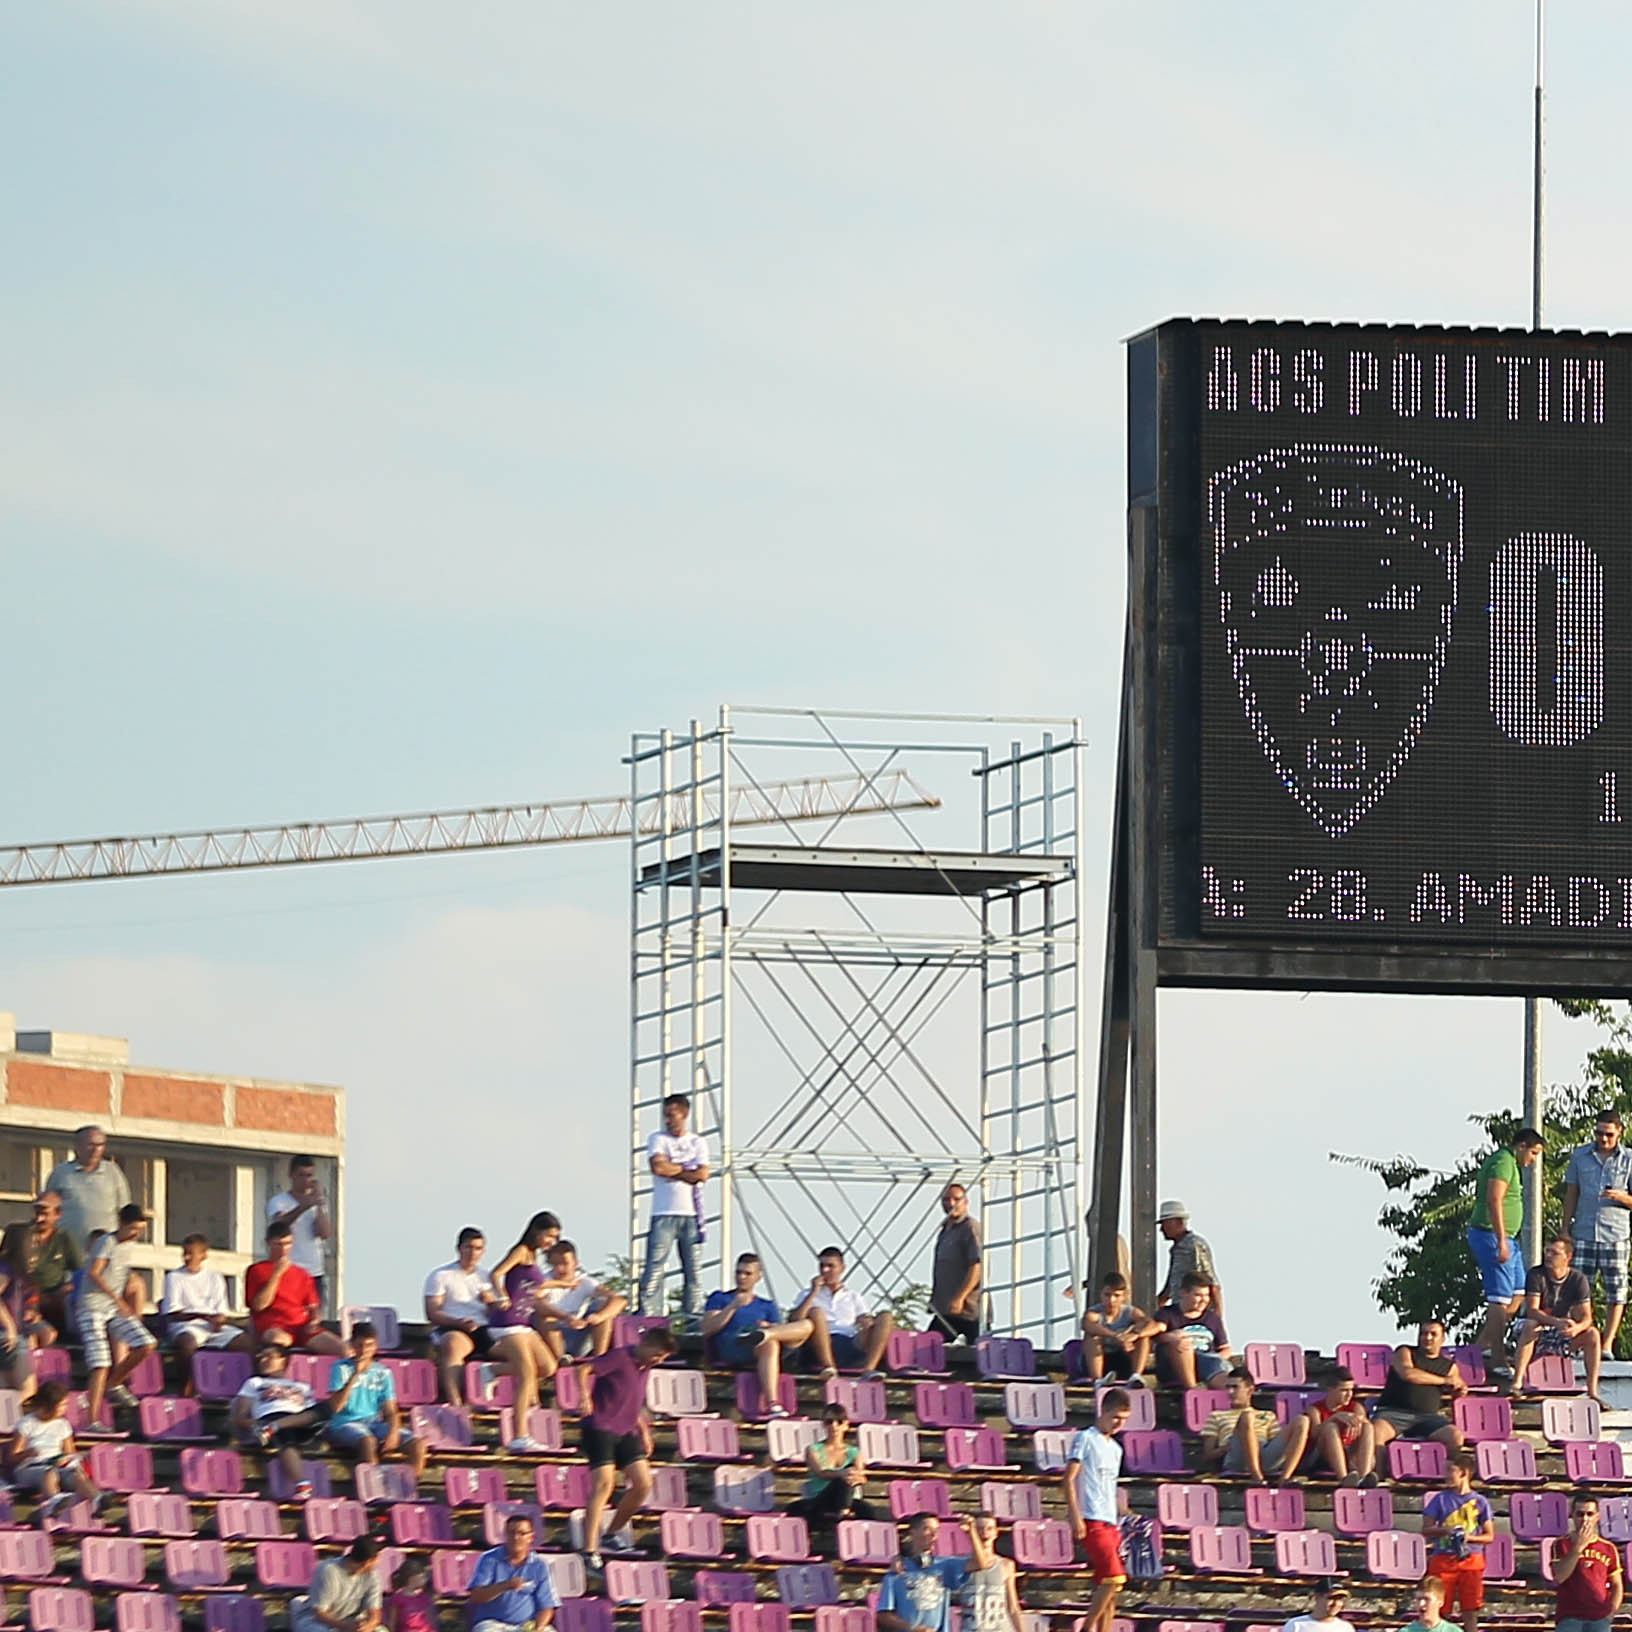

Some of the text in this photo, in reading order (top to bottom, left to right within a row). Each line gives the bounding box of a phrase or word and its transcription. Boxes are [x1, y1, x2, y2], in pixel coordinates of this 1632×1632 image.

[1348, 350, 1477, 420] POLI
[1496, 355, 1605, 424] TIM
[1488, 531, 1605, 747] 0
[1286, 868, 1386, 925] 28.
